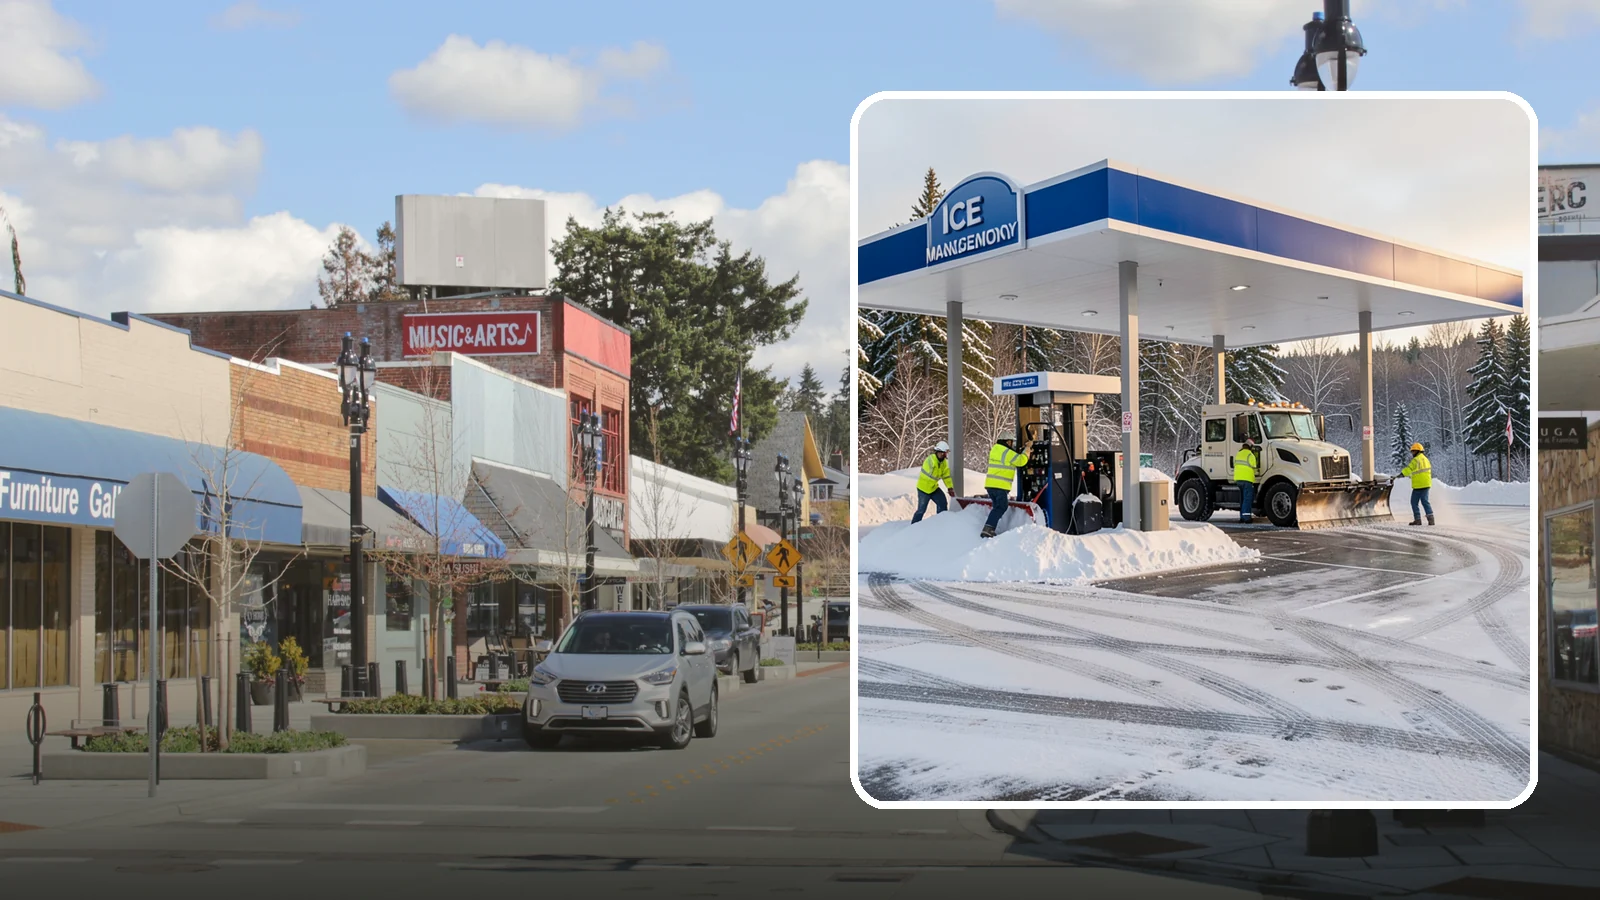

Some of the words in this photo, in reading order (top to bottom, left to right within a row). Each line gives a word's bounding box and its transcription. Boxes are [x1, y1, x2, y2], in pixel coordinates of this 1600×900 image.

[942, 196, 983, 235] ICE
[0, 471, 79, 515] Furniture
[89, 482, 122, 519] Gal
